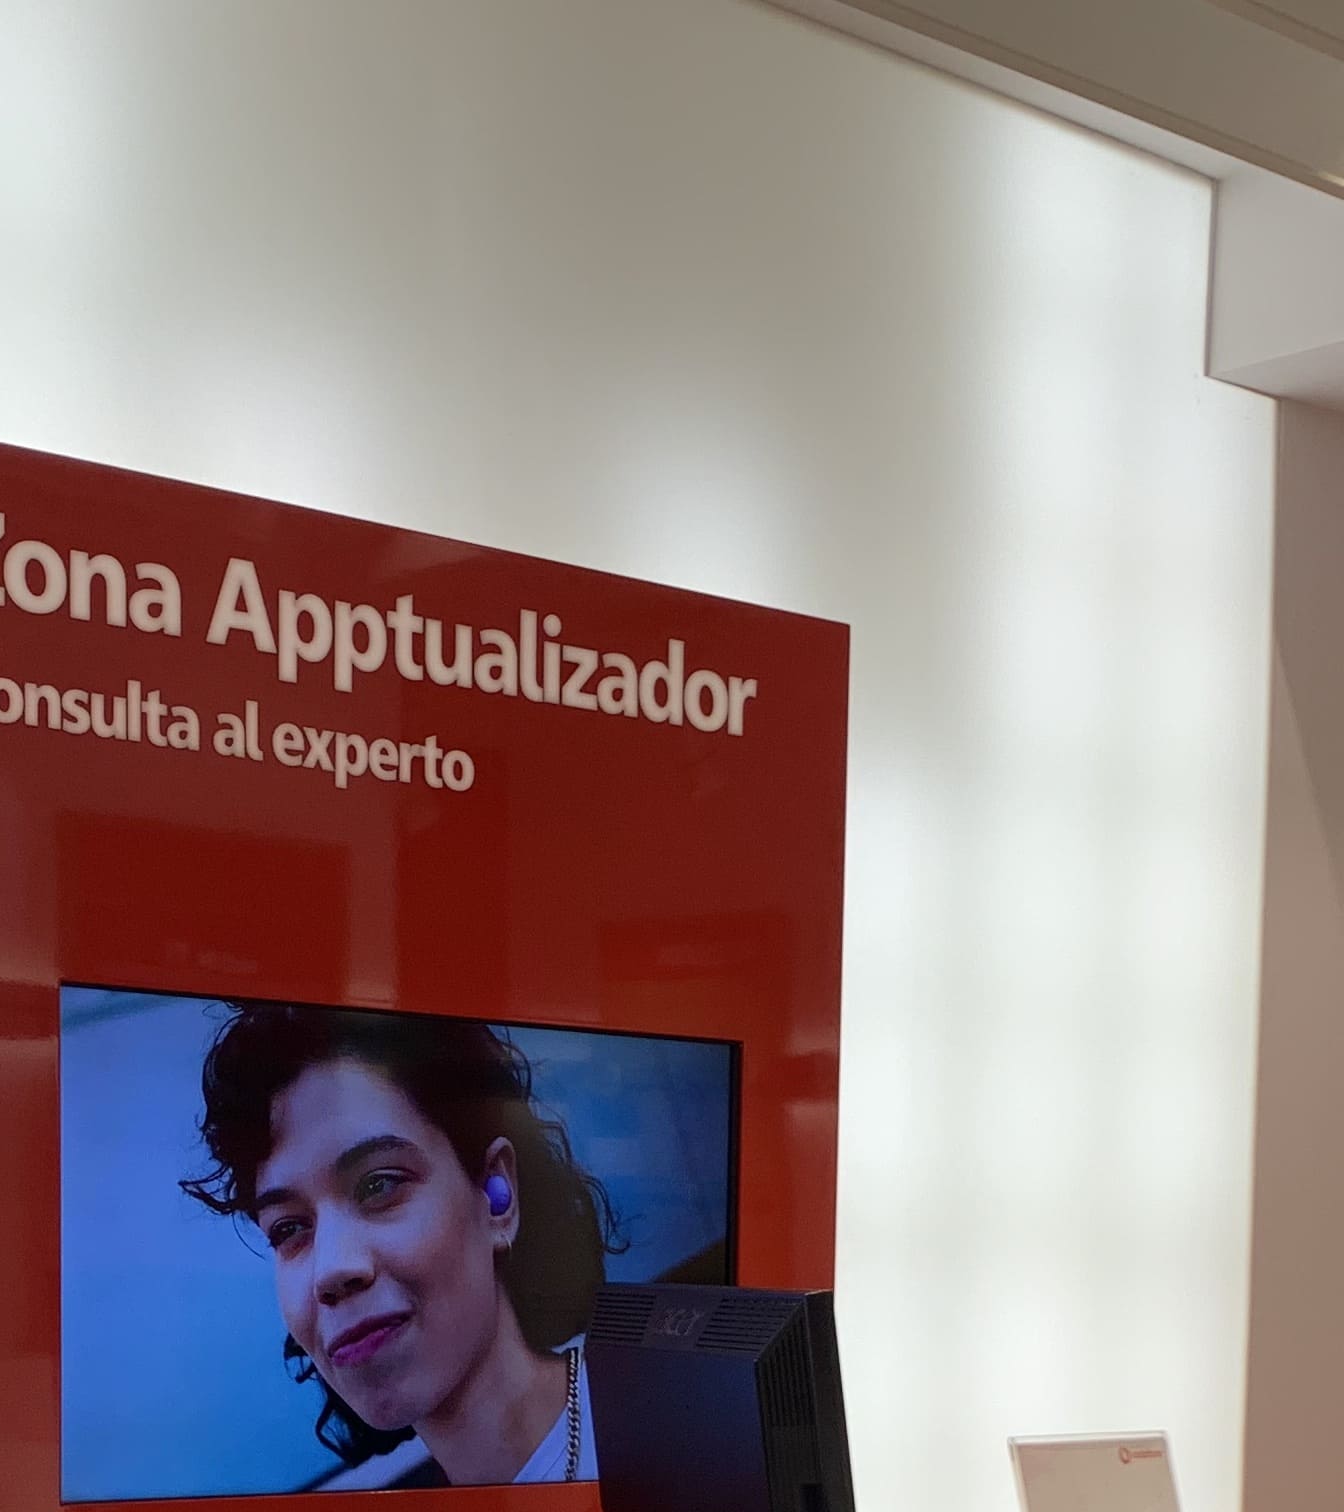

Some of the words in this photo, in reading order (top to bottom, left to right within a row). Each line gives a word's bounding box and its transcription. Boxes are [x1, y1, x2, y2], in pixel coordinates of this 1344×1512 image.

[205, 556, 759, 737] Apptualizador
[213, 699, 263, 761] al
[272, 720, 476, 791] experto
